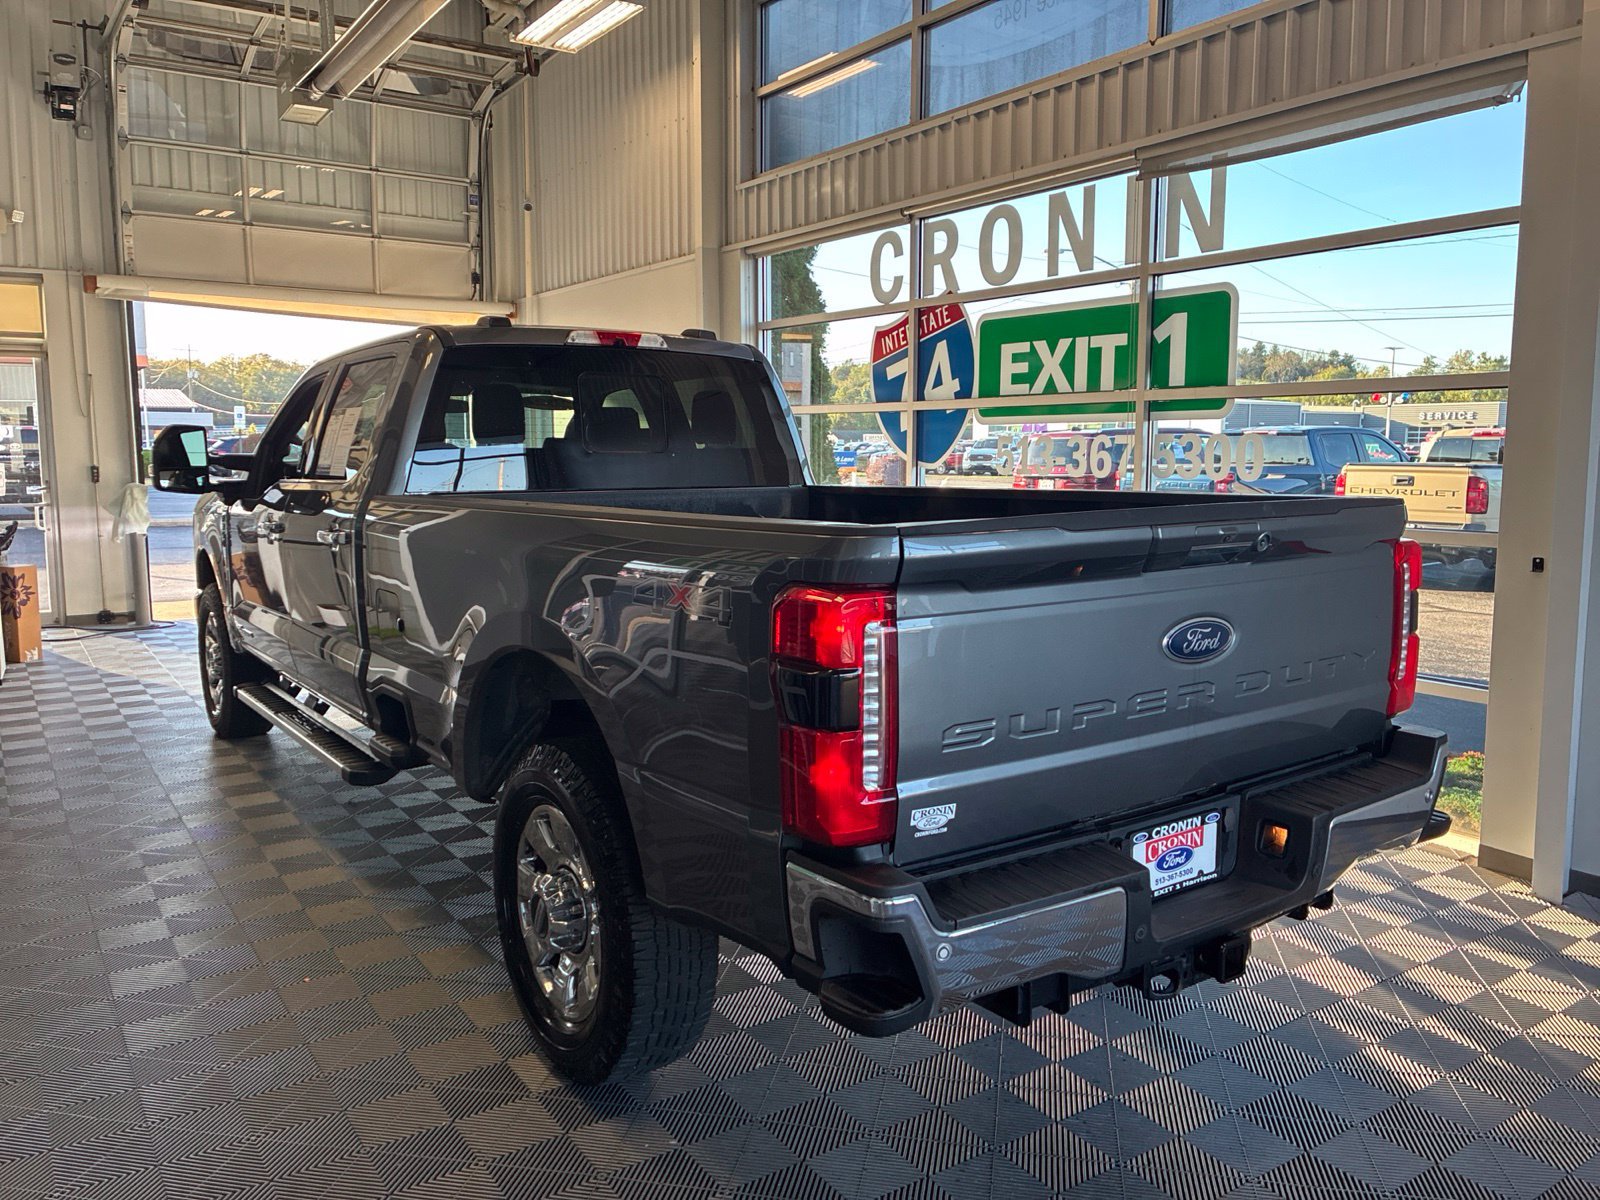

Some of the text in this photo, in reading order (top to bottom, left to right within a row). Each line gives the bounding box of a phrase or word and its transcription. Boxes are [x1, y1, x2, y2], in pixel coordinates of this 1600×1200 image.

[870, 152, 1229, 304] CRONIN
[881, 304, 952, 355] INTETATE
[1000, 312, 1188, 396] EXIT 1
[886, 339, 961, 432] 74
[1418, 411, 1475, 420] SERVICE
[1350, 487, 1460, 497] CHEVROLET
[1183, 627, 1222, 654] Ford
[942, 650, 1376, 753] SUPER DUTY
[912, 804, 955, 822] CRONIN
[1152, 816, 1201, 839] CRONIN
[1148, 830, 1202, 861] CRONIN
[1163, 850, 1187, 869] Ford
[1154, 886, 1174, 897] EXIT
[1182, 873, 1217, 887] Harrison
[1155, 868, 1193, 885] 513-367-5300
